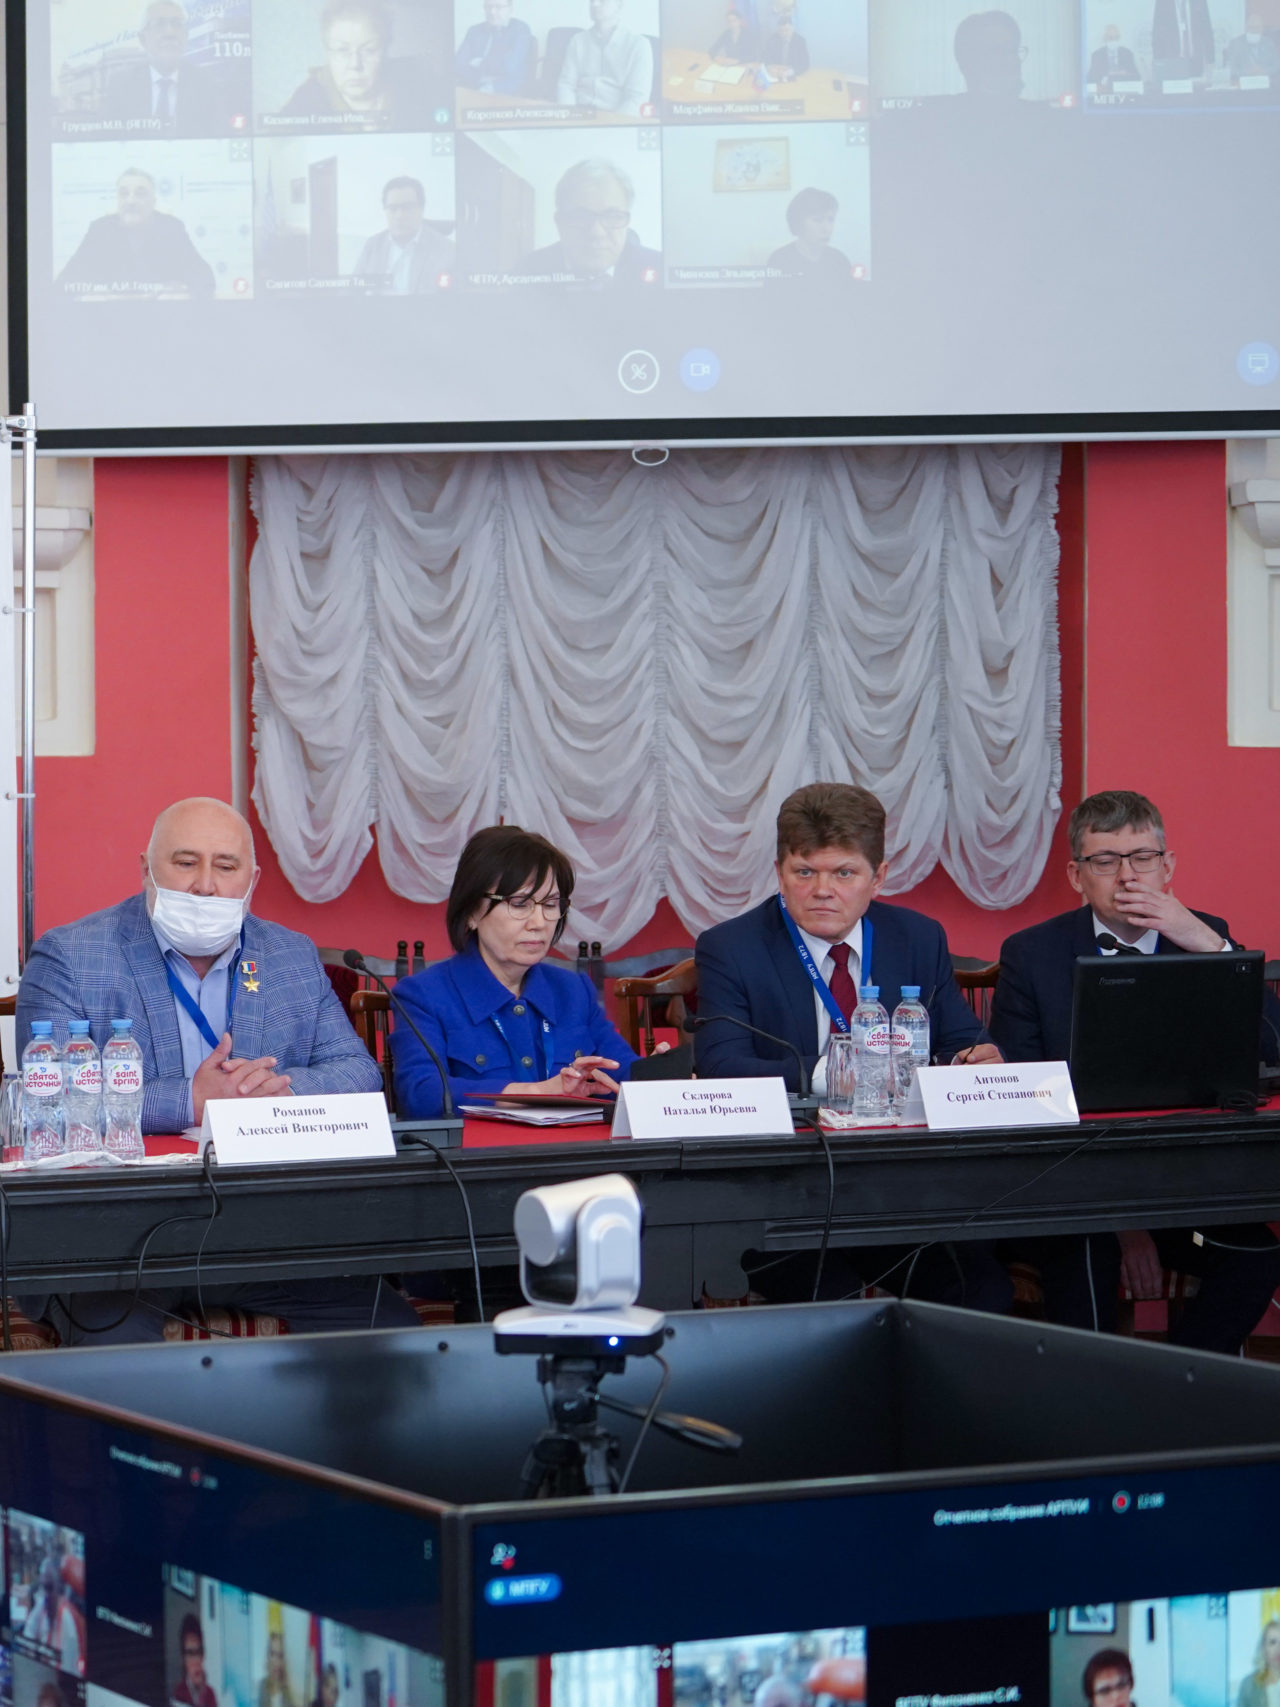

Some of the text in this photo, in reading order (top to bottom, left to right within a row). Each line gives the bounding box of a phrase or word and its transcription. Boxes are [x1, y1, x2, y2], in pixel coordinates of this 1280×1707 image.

[798, 944, 820, 980] МПГУ 1872
[836, 1016, 848, 1033] 1872
[28, 1072, 59, 1081] святой
[115, 1070, 138, 1078] saint
[974, 1074, 1020, 1085] Антонов
[113, 1078, 140, 1087] spring
[682, 1091, 733, 1102] Склярова
[946, 1089, 1052, 1104] Сергей Степанович
[272, 1106, 327, 1118] Романов
[663, 1104, 758, 1116] Наталья Юрьевна
[236, 1121, 369, 1137] Алексей Викторович
